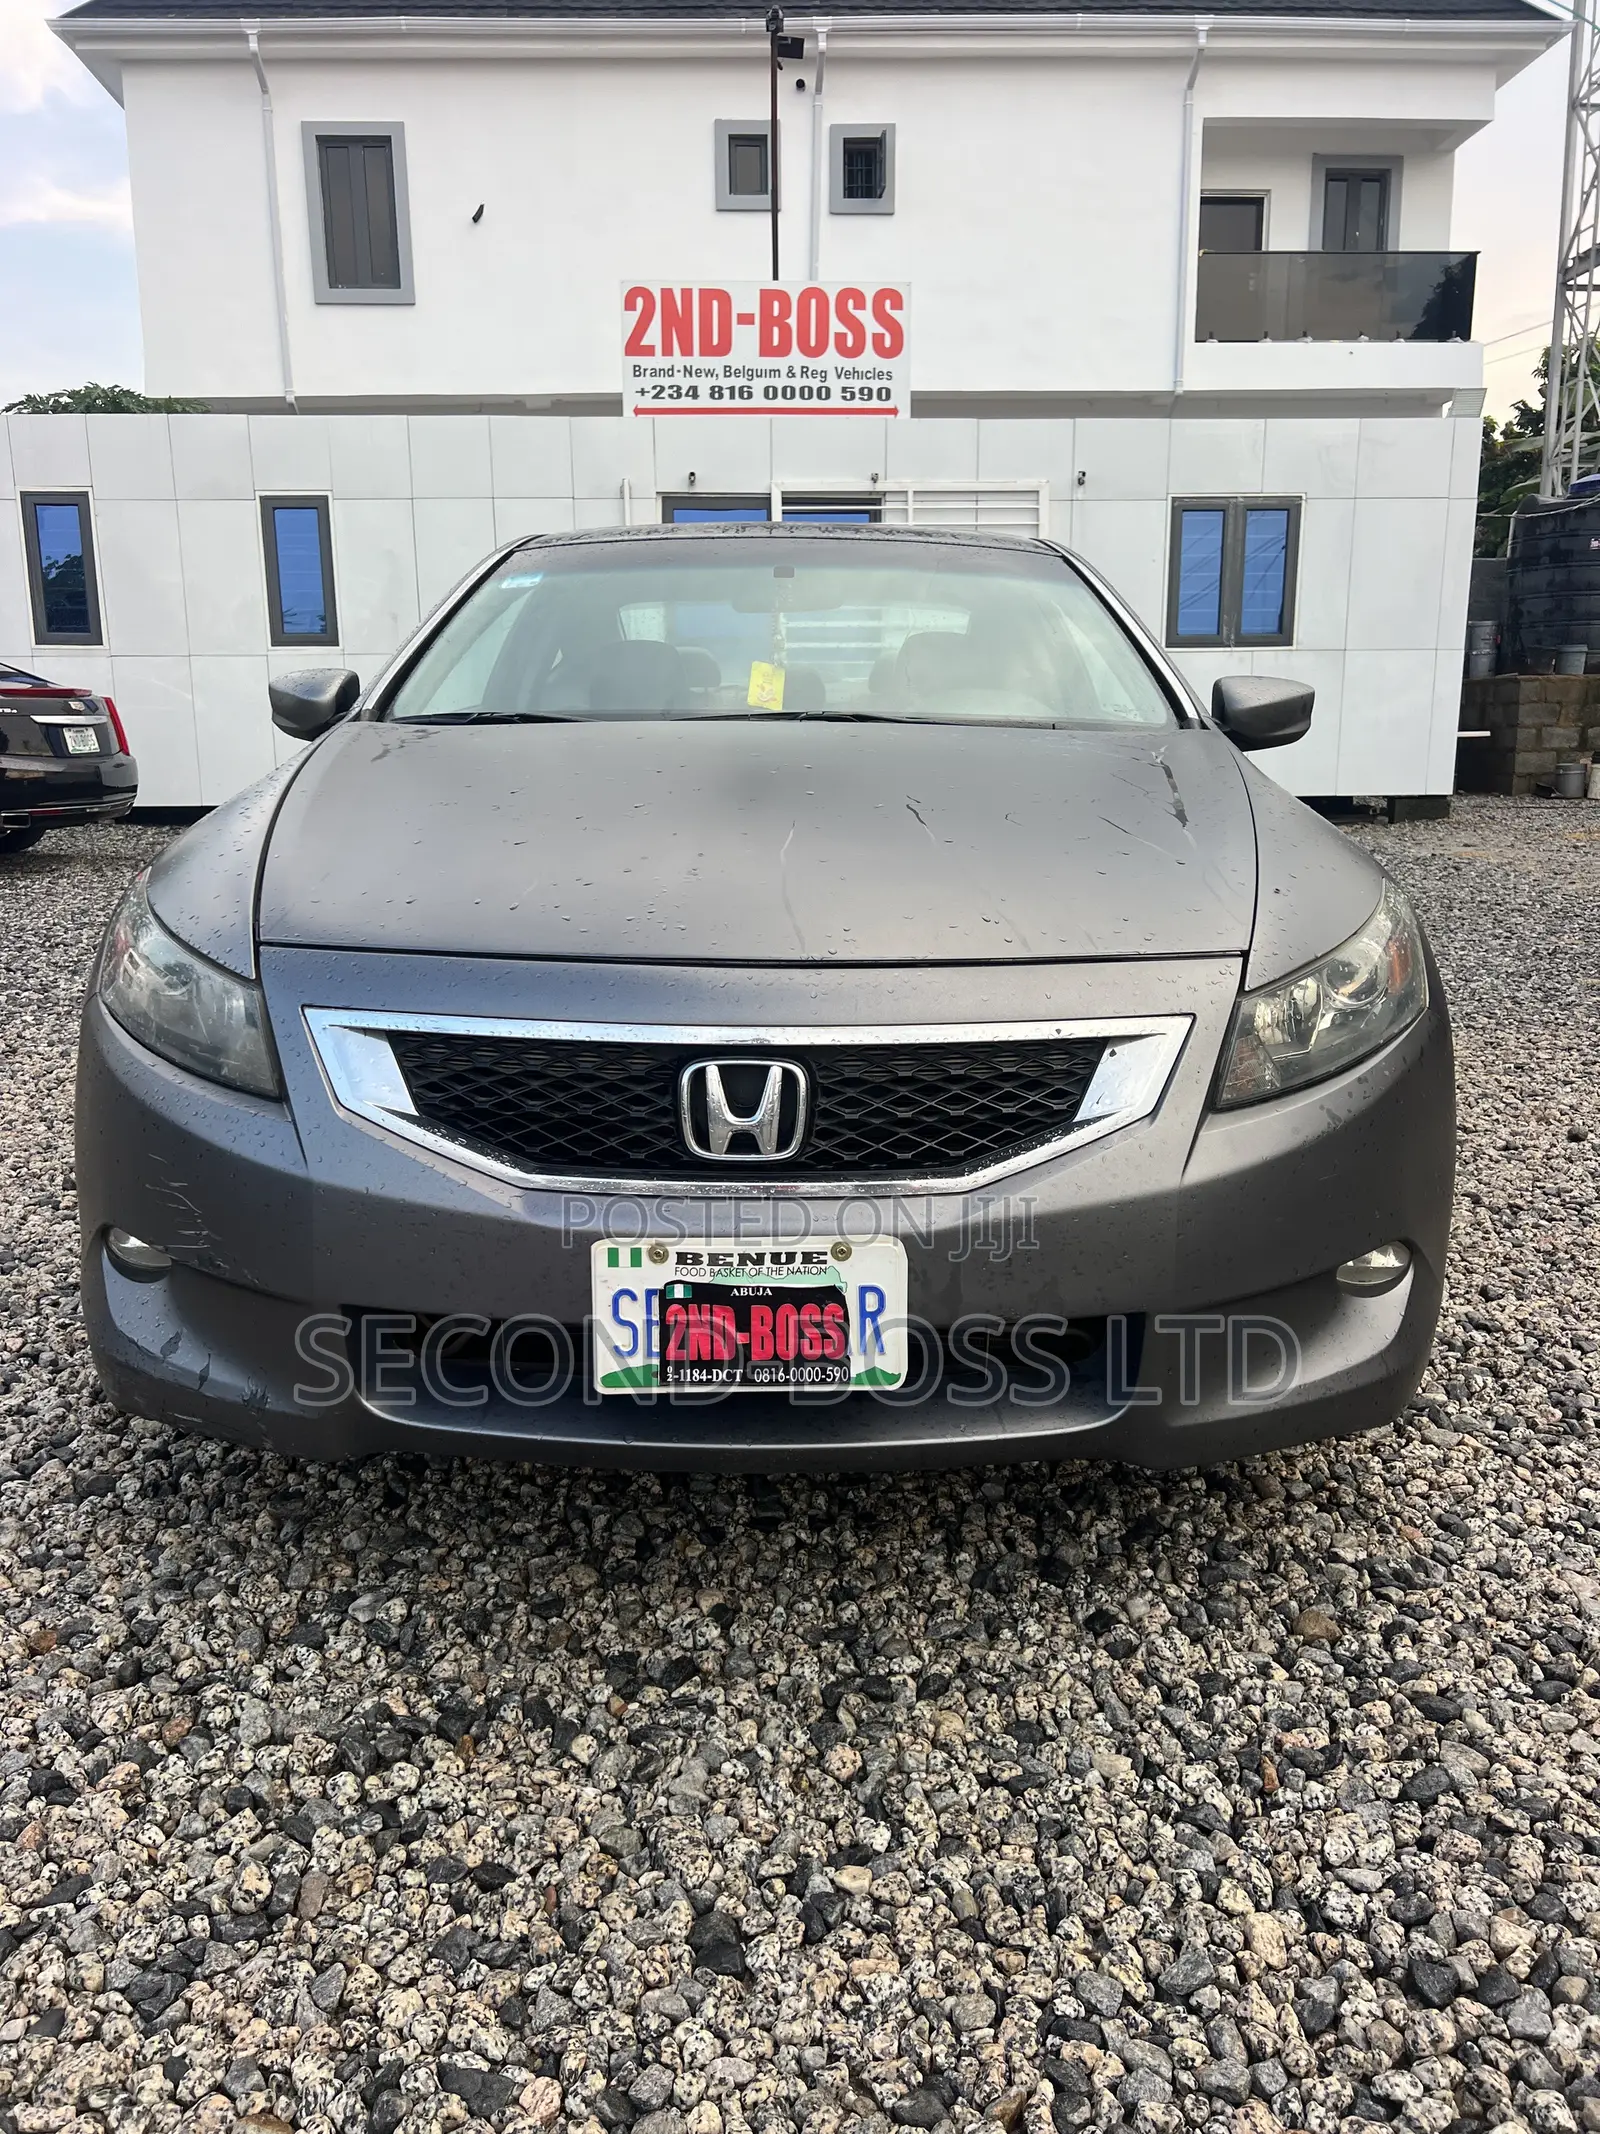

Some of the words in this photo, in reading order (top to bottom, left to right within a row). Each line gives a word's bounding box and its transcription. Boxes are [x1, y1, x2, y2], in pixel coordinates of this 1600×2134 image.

[624, 286, 904, 360] 2ND-BOSS
[632, 364, 719, 381] Brand-New,
[786, 365, 797, 379] &
[800, 365, 828, 383] Reg
[834, 366, 893, 381] Vehicles
[635, 384, 700, 400] +234
[709, 385, 753, 400] 816
[763, 385, 831, 400] 0000
[840, 386, 891, 402] 590
[675, 1251, 828, 1267] BENUE
[674, 1266, 707, 1277] FOOD
[709, 1266, 746, 1278] BASKET
[748, 1267, 764, 1278] OF
[766, 1266, 785, 1276] THE
[786, 1265, 828, 1276] NATION
[730, 1287, 773, 1297] ABUJA
[665, 1303, 847, 1361] 2ND-BOSS
[754, 1366, 849, 1383] 0816-0000-590
